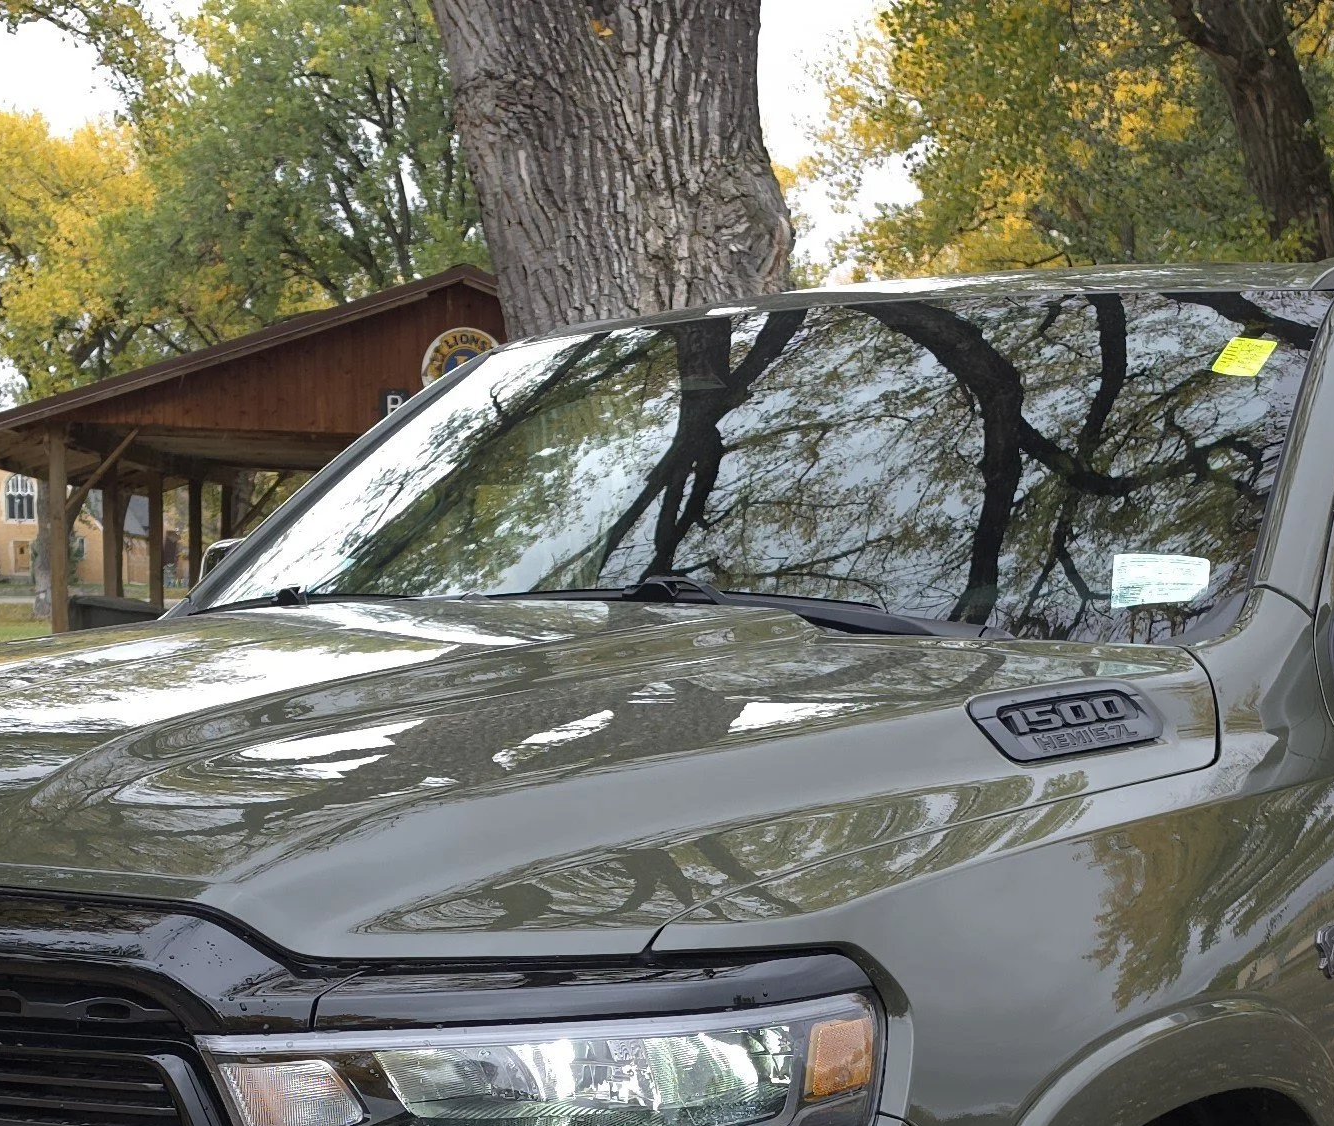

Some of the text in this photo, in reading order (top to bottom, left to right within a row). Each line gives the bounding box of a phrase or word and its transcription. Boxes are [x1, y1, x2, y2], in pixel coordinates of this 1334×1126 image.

[1004, 695, 1127, 735] 1500
[1033, 723, 1139, 753] HEMI 5.7L
